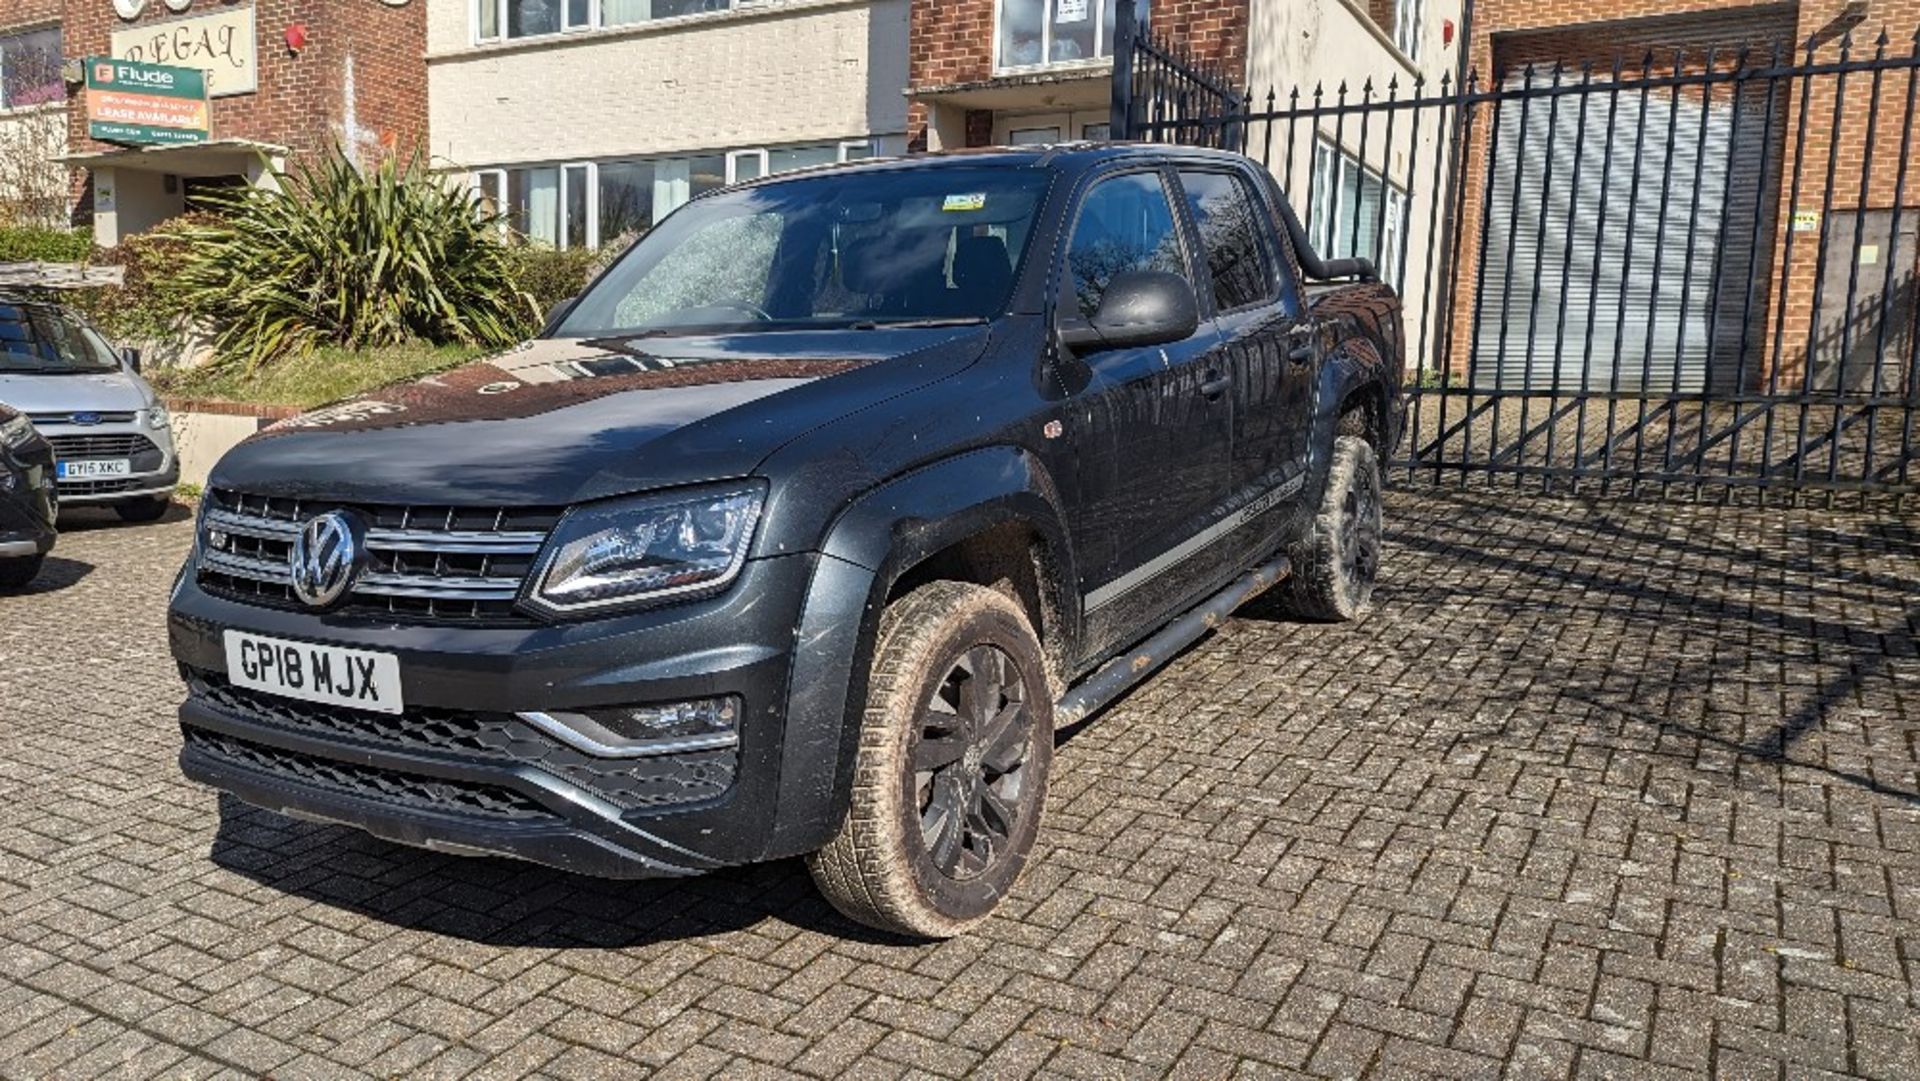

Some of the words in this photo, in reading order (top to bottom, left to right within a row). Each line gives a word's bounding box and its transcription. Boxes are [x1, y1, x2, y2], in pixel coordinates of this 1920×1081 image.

[118, 66, 174, 84] Flude
[68, 463, 96, 475] GY15
[99, 461, 125, 474] XKC
[241, 639, 304, 689] GP18
[311, 650, 379, 702] MJX
